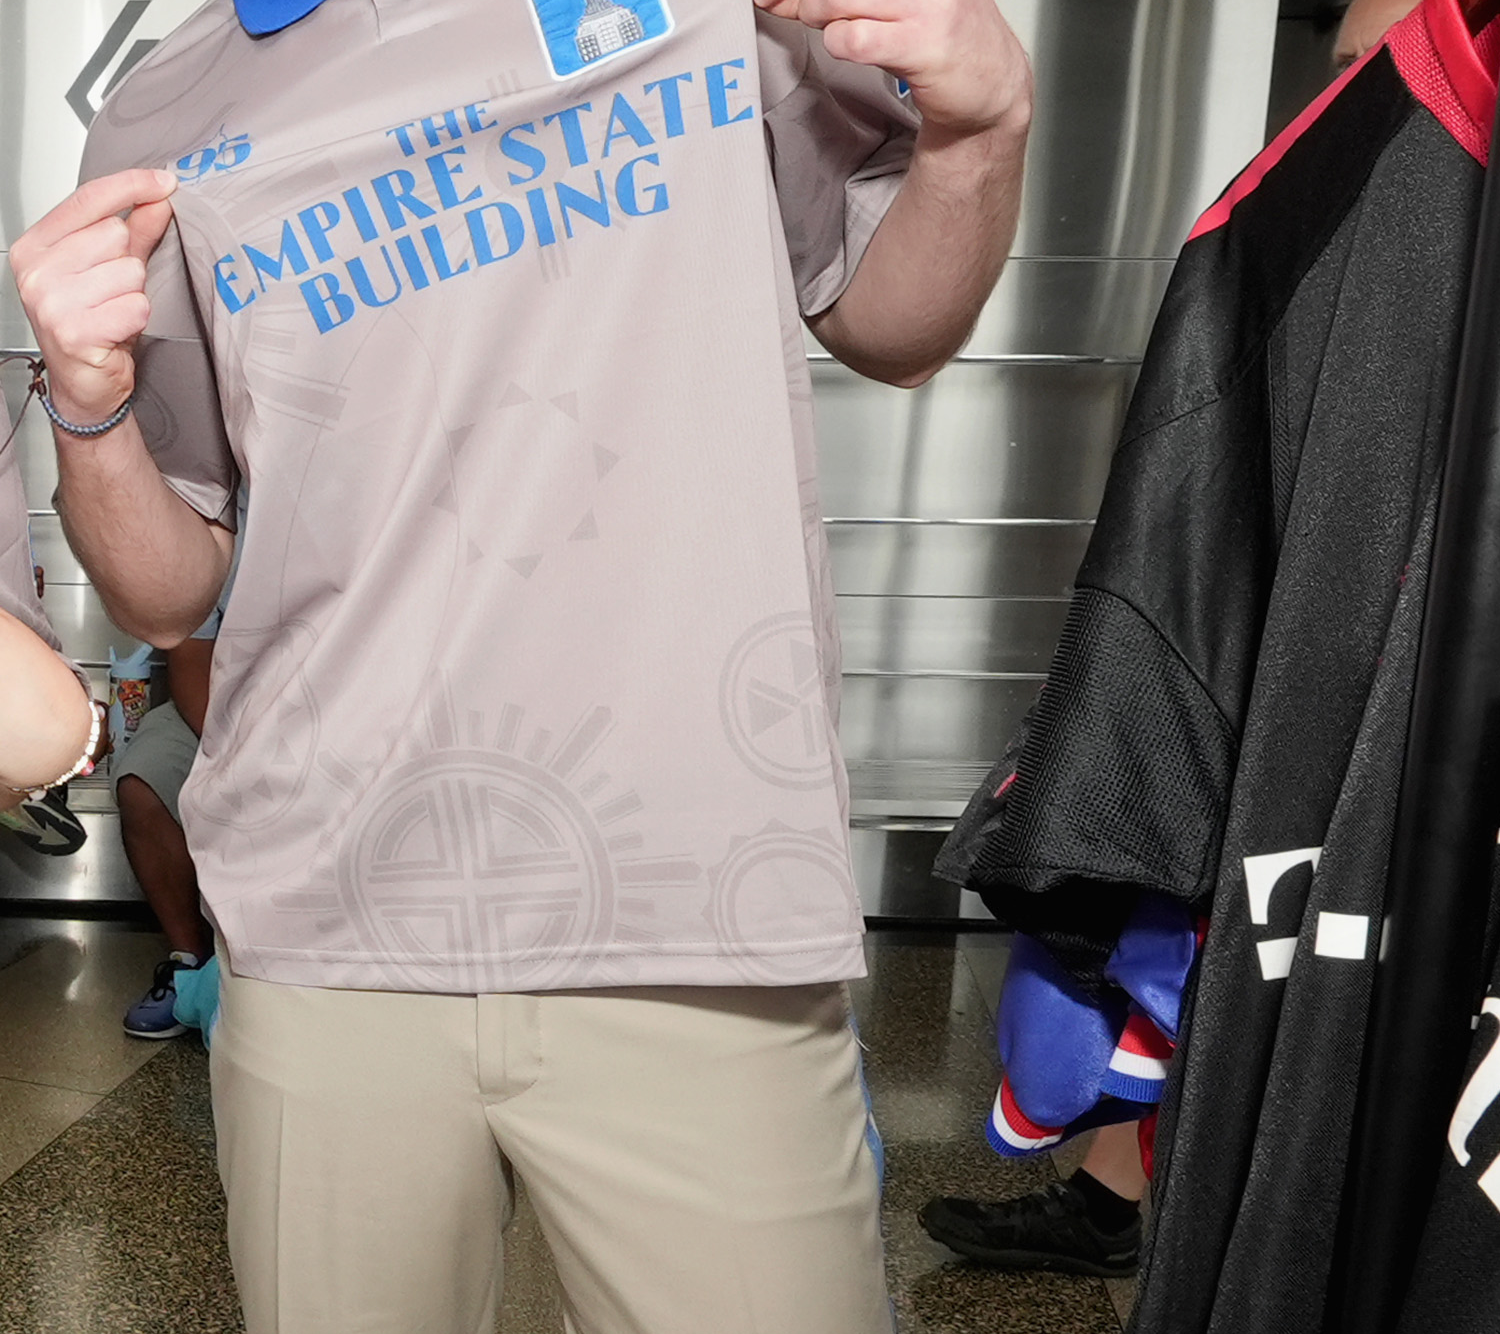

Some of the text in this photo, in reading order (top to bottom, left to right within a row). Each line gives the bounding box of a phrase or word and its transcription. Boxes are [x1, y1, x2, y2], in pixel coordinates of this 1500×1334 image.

[176, 133, 252, 183] 95
[213, 58, 755, 316] EMPIRE STATE
[386, 100, 498, 157] THE
[298, 152, 671, 334] BUILDING
